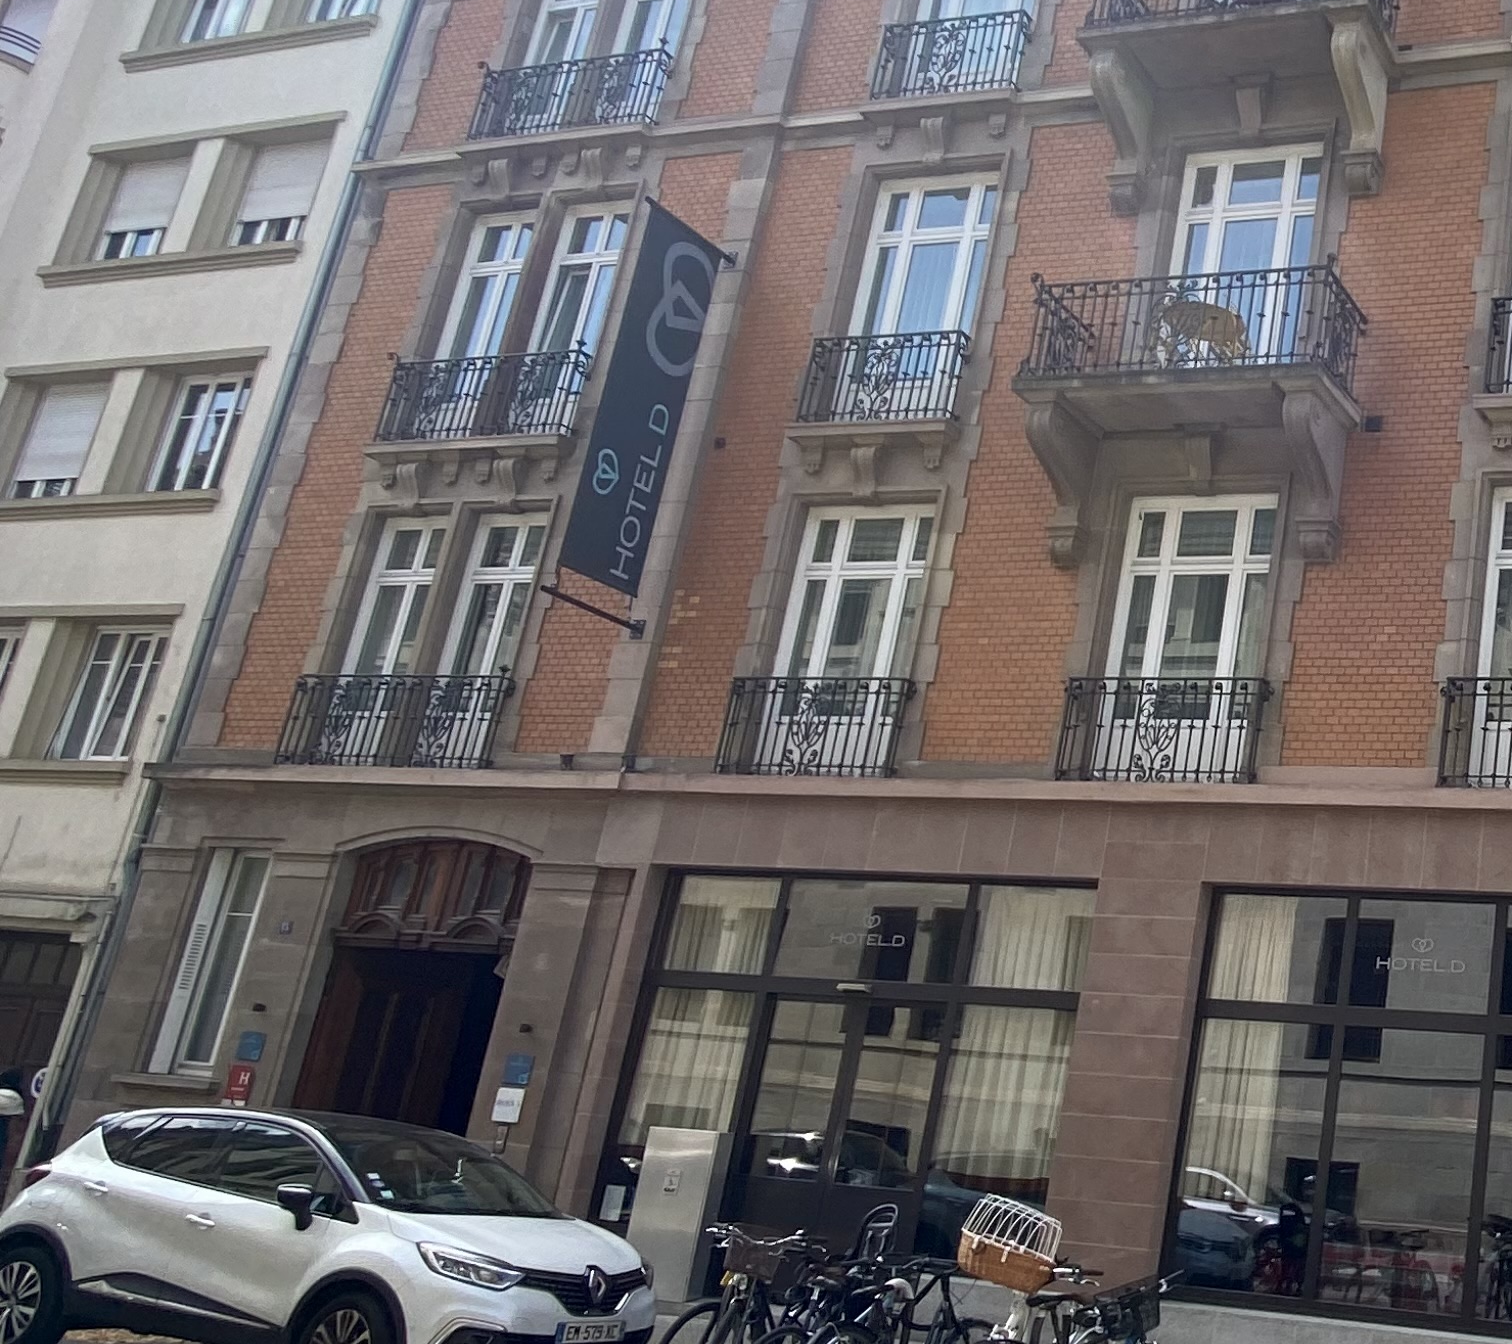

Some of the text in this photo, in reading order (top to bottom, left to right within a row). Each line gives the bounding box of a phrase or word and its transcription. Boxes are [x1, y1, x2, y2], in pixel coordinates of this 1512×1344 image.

[609, 403, 670, 580] HOTEL D
[238, 1071, 251, 1085] H
